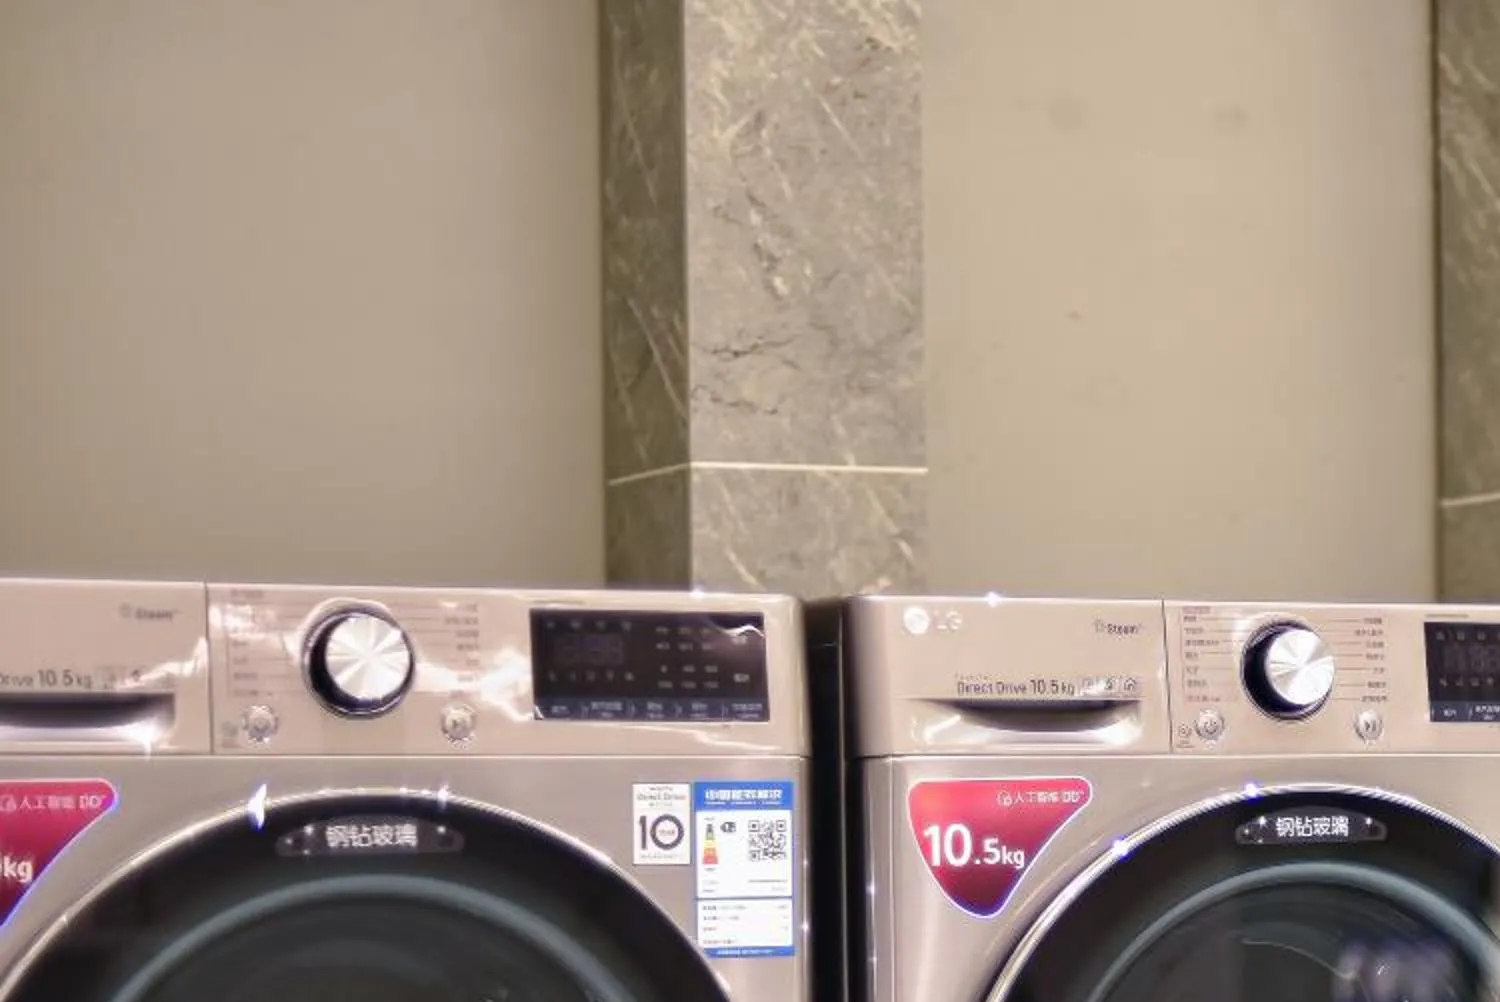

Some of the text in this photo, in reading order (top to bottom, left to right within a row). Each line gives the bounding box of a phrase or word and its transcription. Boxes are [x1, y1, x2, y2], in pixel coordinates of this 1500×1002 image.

[957, 681, 993, 696] Direct
[995, 681, 1027, 694] Drive
[639, 814, 685, 850] 10
[1275, 815, 1349, 838] 钢钻玻璃
[0, 855, 33, 883] kg
